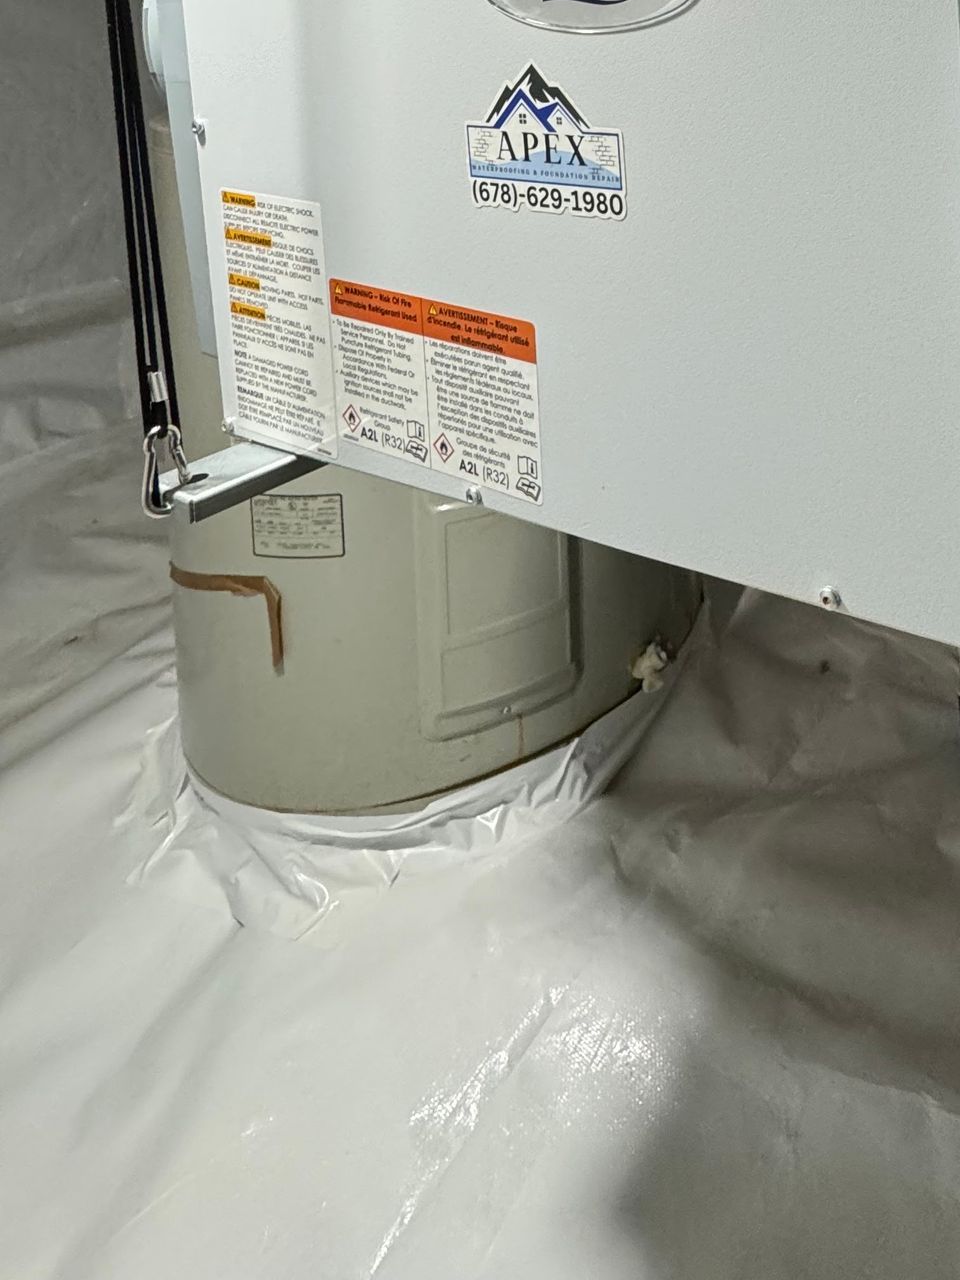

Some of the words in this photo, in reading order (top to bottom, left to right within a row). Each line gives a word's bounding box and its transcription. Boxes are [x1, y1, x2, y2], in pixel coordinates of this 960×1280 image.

[496, 130, 588, 167] APEX
[540, 169, 588, 180] FOUNDATION
[591, 173, 620, 183] REPAIR
[229, 197, 255, 207] WARNING
[472, 179, 623, 215] (678)-629-1980
[236, 277, 260, 290] CAUTION
[344, 285, 372, 299] WARNING
[379, 293, 390, 303] Risk
[392, 296, 399, 305] Of
[400, 297, 411, 308] Fire
[438, 306, 488, 325] AVERTISSEMENT
[495, 320, 517, 333] Risque
[360, 425, 378, 442] A2L
[381, 431, 405, 454] (R32)
[458, 458, 479, 476] A2L
[482, 464, 509, 490] (R32)
